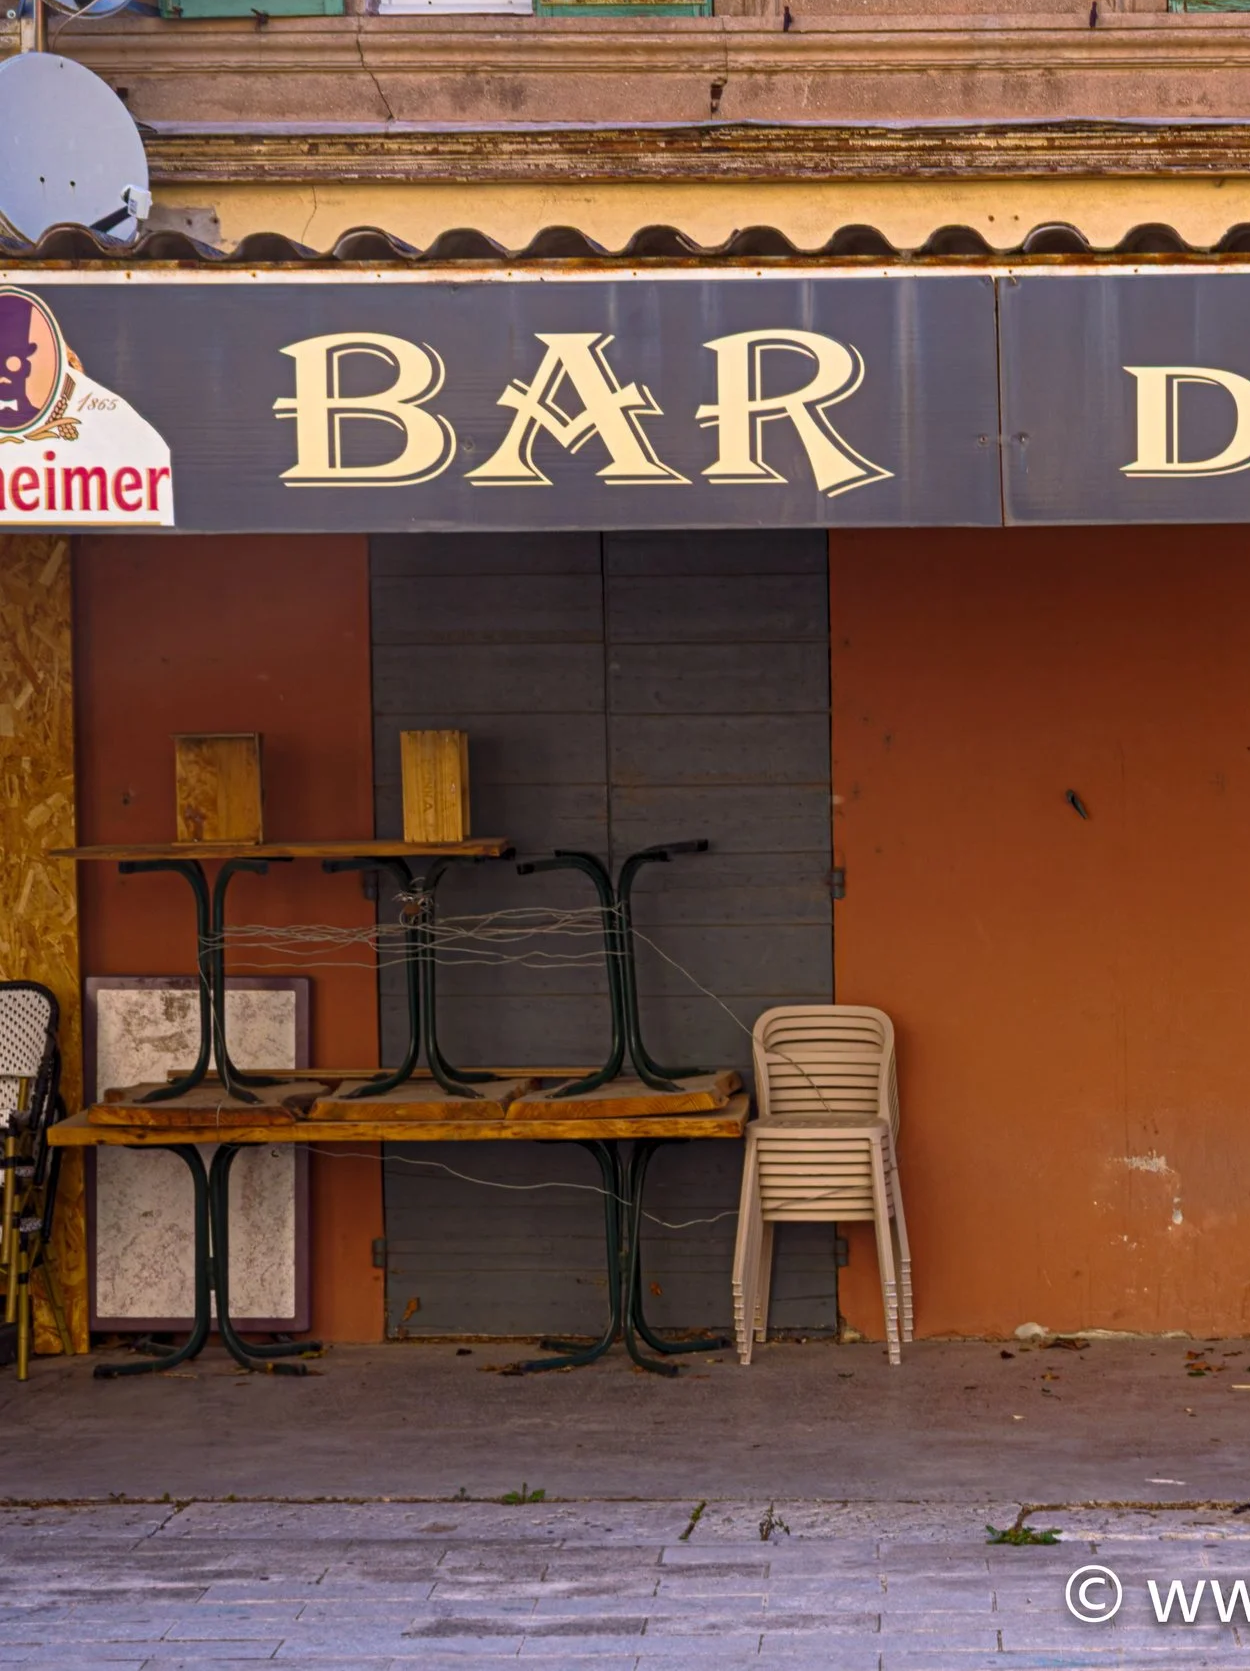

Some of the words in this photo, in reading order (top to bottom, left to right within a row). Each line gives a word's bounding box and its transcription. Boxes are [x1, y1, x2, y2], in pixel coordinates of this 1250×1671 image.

[77, 392, 119, 412] 1865
[273, 329, 897, 497] BAR
[0, 450, 170, 512] eimer
